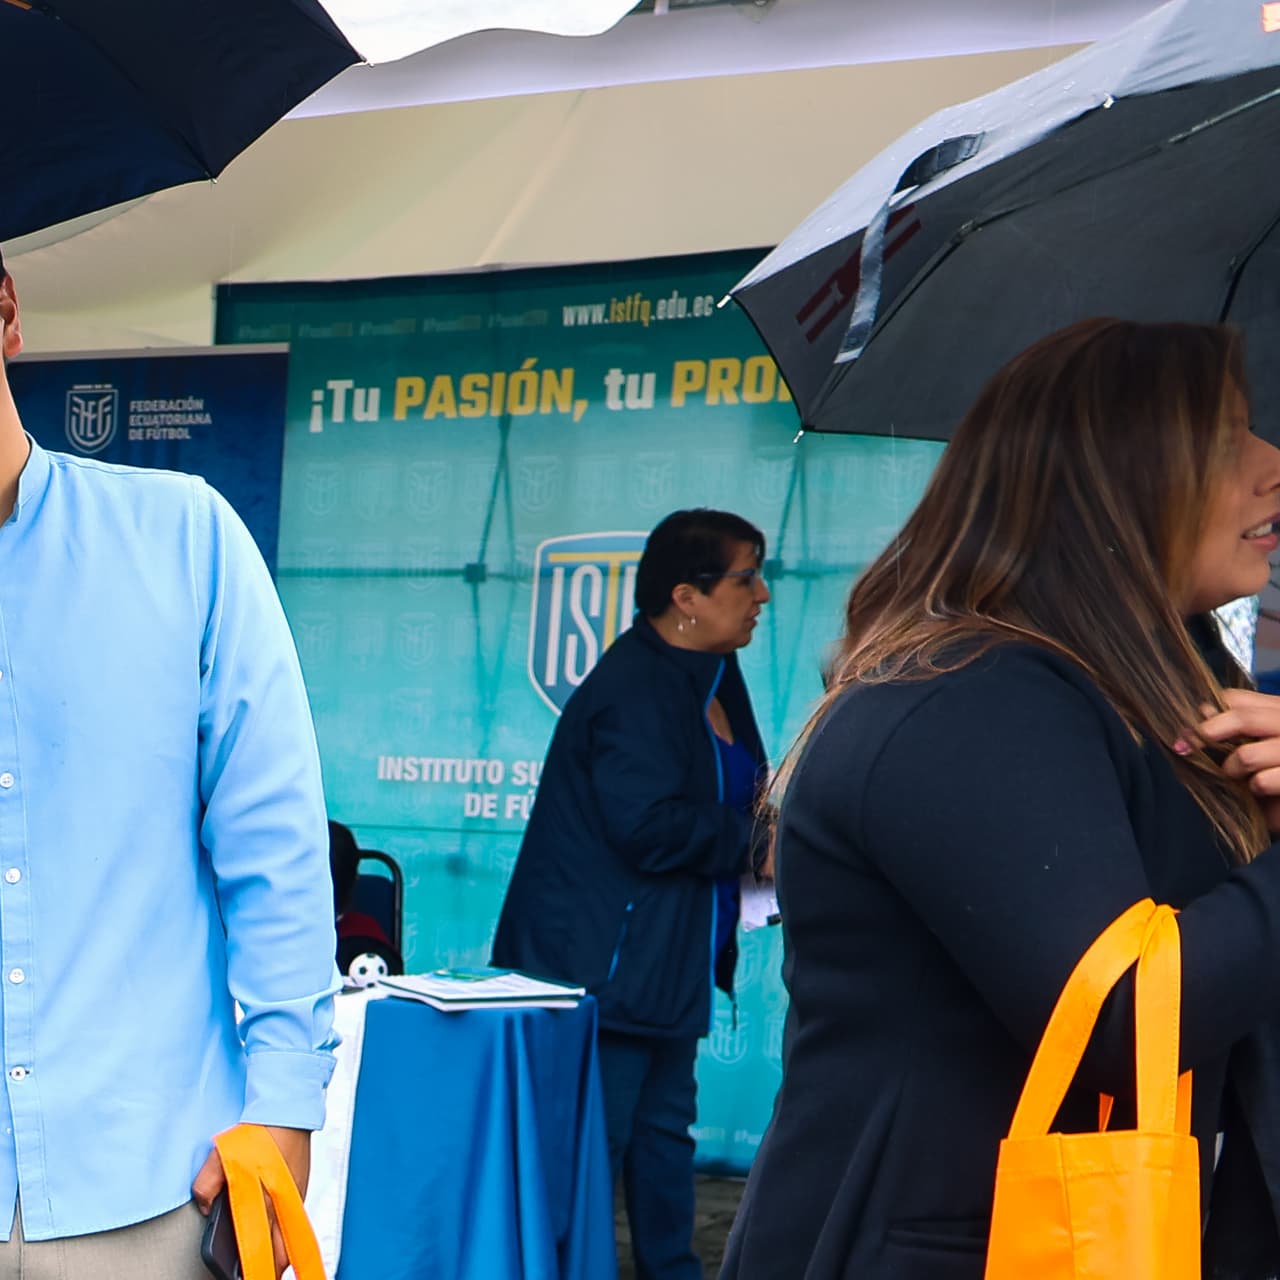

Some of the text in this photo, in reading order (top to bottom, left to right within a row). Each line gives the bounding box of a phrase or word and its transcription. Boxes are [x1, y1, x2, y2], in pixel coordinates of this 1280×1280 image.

[562, 294, 715, 328] www.istfq.edu.ec
[129, 395, 205, 412] FEDERACIÓN
[309, 379, 381, 434] ¡Tu
[393, 356, 589, 422] PASIÓN,
[603, 367, 657, 411] tu
[127, 425, 192, 441] DE FÚTBOL
[128, 413, 213, 428] ECUATORIANA
[377, 755, 505, 786] INSTITUTO
[464, 792, 498, 819] DE
